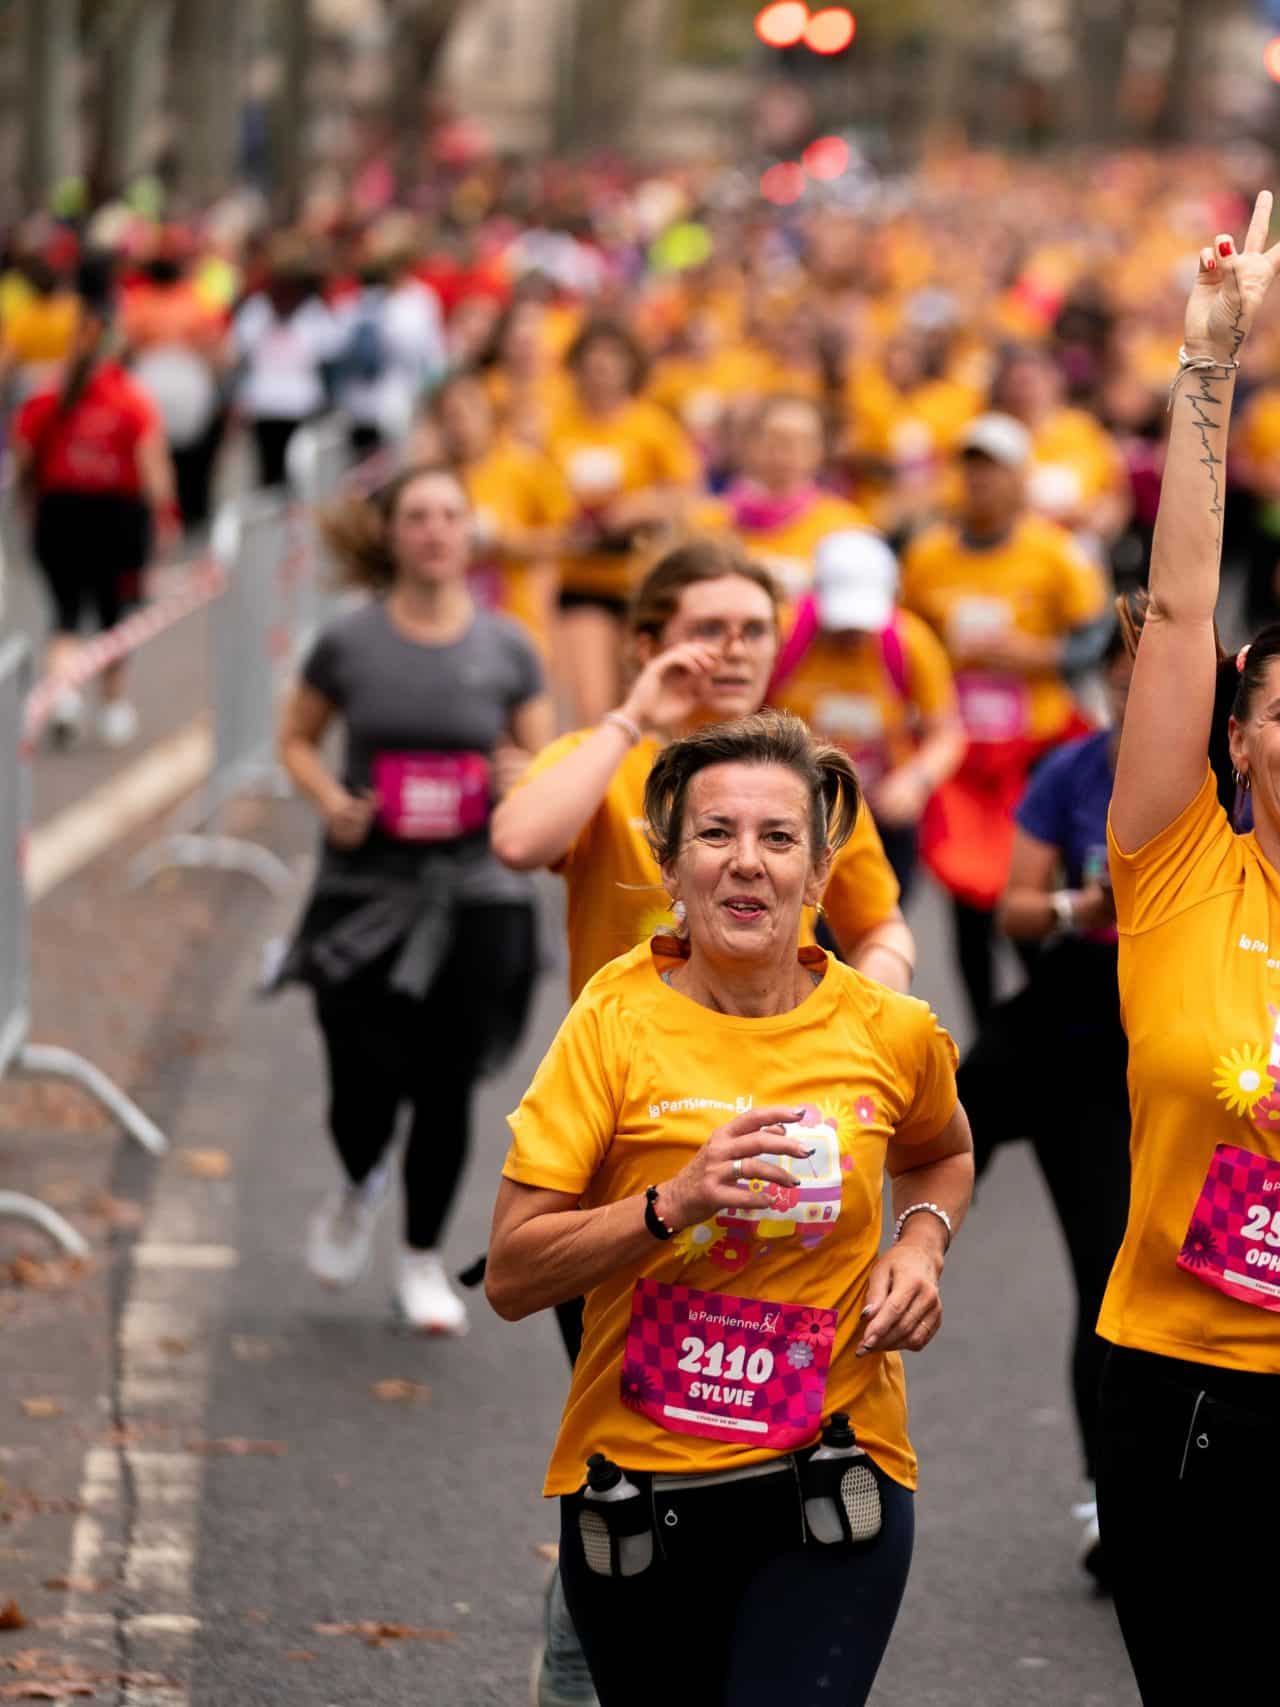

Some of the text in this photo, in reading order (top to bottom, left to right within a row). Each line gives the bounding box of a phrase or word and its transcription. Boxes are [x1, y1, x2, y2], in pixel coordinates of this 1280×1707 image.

[699, 1311, 760, 1331] Parisienne
[678, 1336, 775, 1384] 2110
[688, 1381, 756, 1407] SYLVIE
